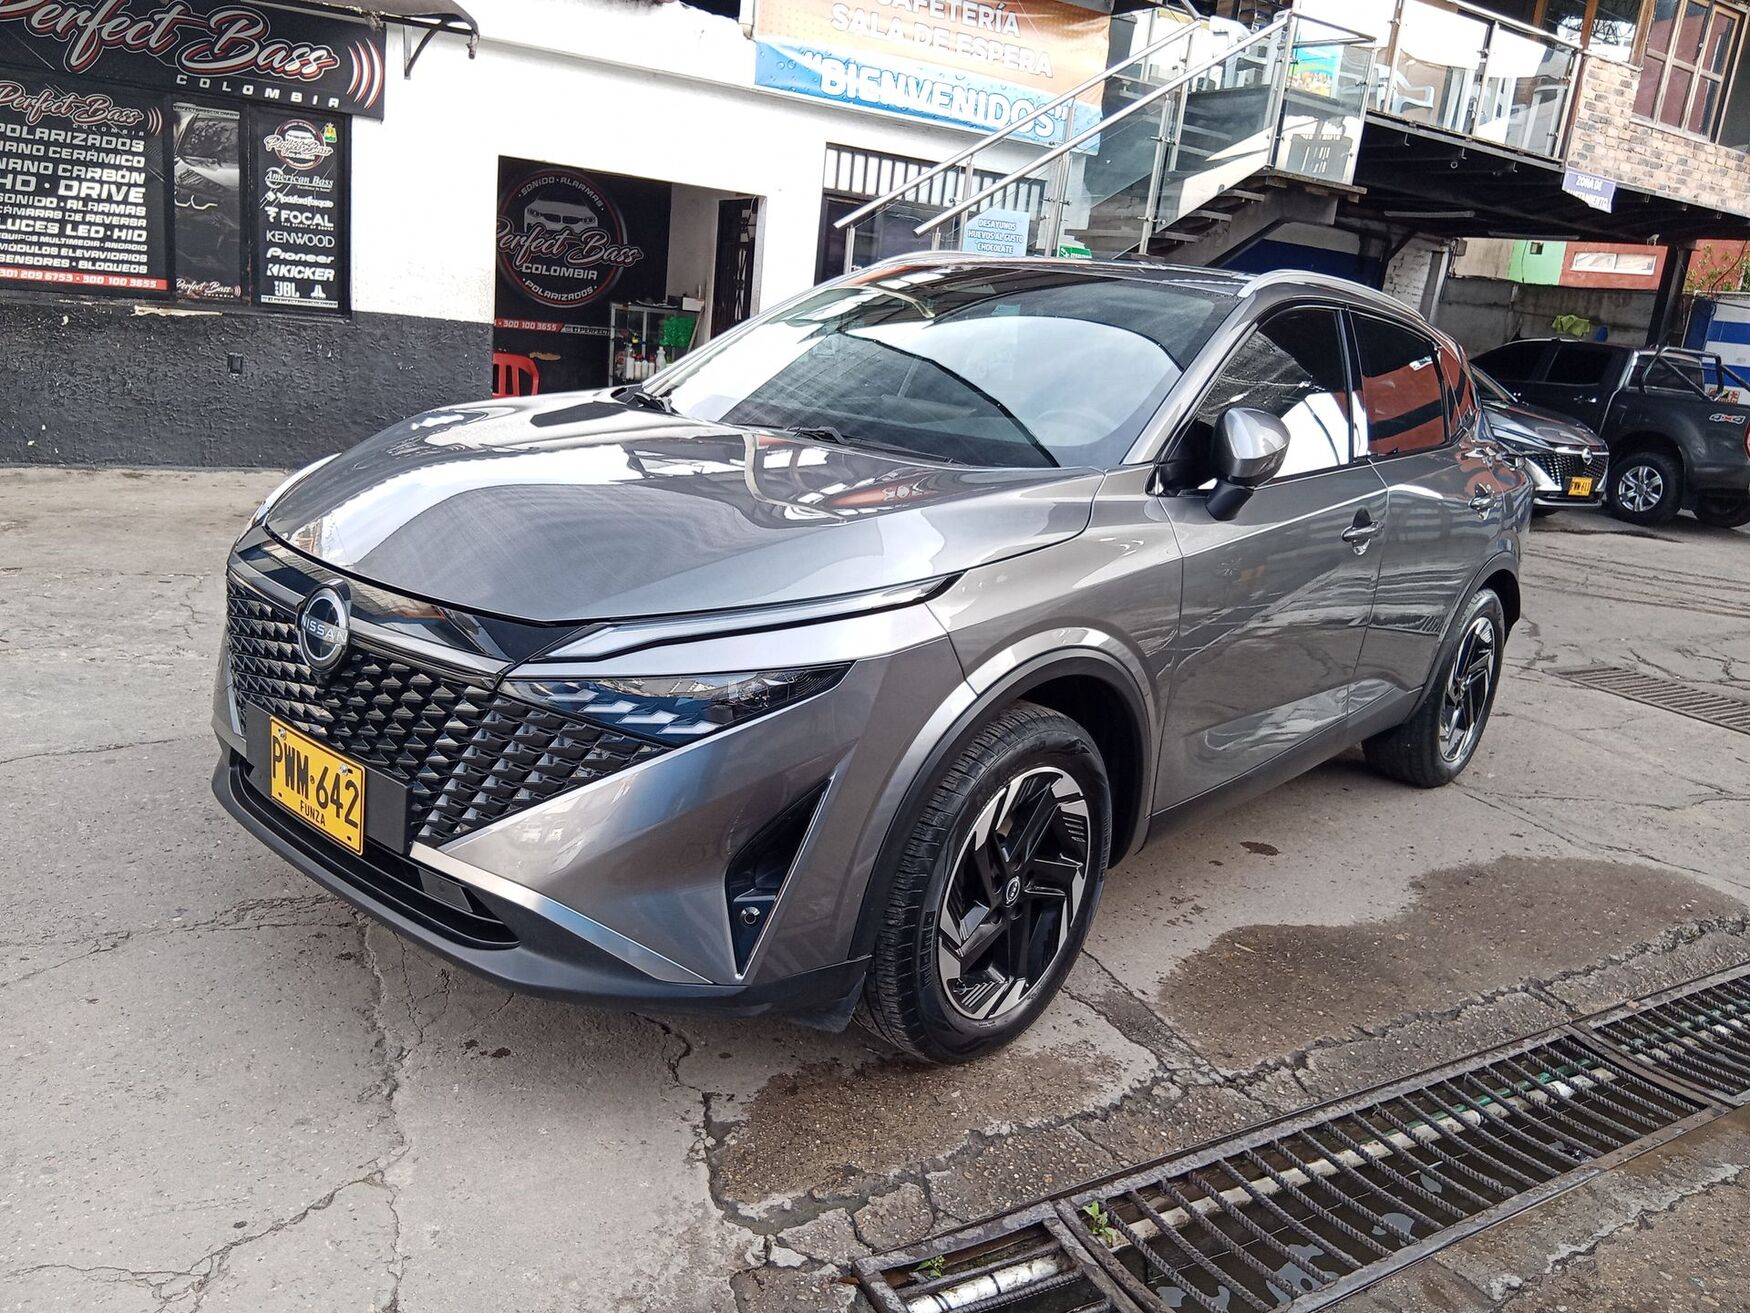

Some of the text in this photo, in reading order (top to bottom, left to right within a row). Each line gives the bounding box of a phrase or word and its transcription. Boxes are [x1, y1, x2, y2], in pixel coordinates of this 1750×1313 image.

[176, 9, 339, 80] Bass
[831, 3, 1054, 78] SALA DE ESPERA
[176, 75, 340, 108] COLOMBIA
[72, 94, 144, 125] Bass
[73, 124, 145, 136] COLOMBIA
[48, 146, 145, 168] CERÁMICO
[57, 164, 146, 184] CARBÓN
[265, 171, 334, 187] American Bass
[58, 179, 146, 203] DRIVE
[520, 176, 604, 207] SONIDO ALARMAS
[66, 199, 146, 216] ALARMAS
[65, 212, 83, 221] DE
[85, 213, 147, 227] REVERSA
[281, 210, 334, 227] FOCAL
[65, 223, 105, 238] LED
[112, 227, 147, 242] HID
[266, 229, 335, 248] KENWOOD
[968, 229, 994, 240] HUEVOS
[1004, 233, 1024, 243] GUSTO
[39, 236, 100, 247] MULTIMEDIA
[105, 241, 148, 251] ANDROID
[564, 229, 643, 267] Bass
[60, 248, 148, 263] ELEVAVIDRIOS
[266, 247, 334, 264] Pioneer
[78, 260, 148, 274] BLOQUEOS
[279, 264, 335, 281] KICKER
[522, 264, 598, 280] COLOMBIA
[20, 270, 43, 280] 209
[83, 274, 104, 284] 300
[108, 277, 127, 286] 100
[129, 278, 157, 288] 3655
[275, 281, 300, 297] JBL
[525, 279, 593, 301] POLARIZADOS
[302, 614, 348, 642] NISSAN
[300, 800, 326, 827] FUNZA
